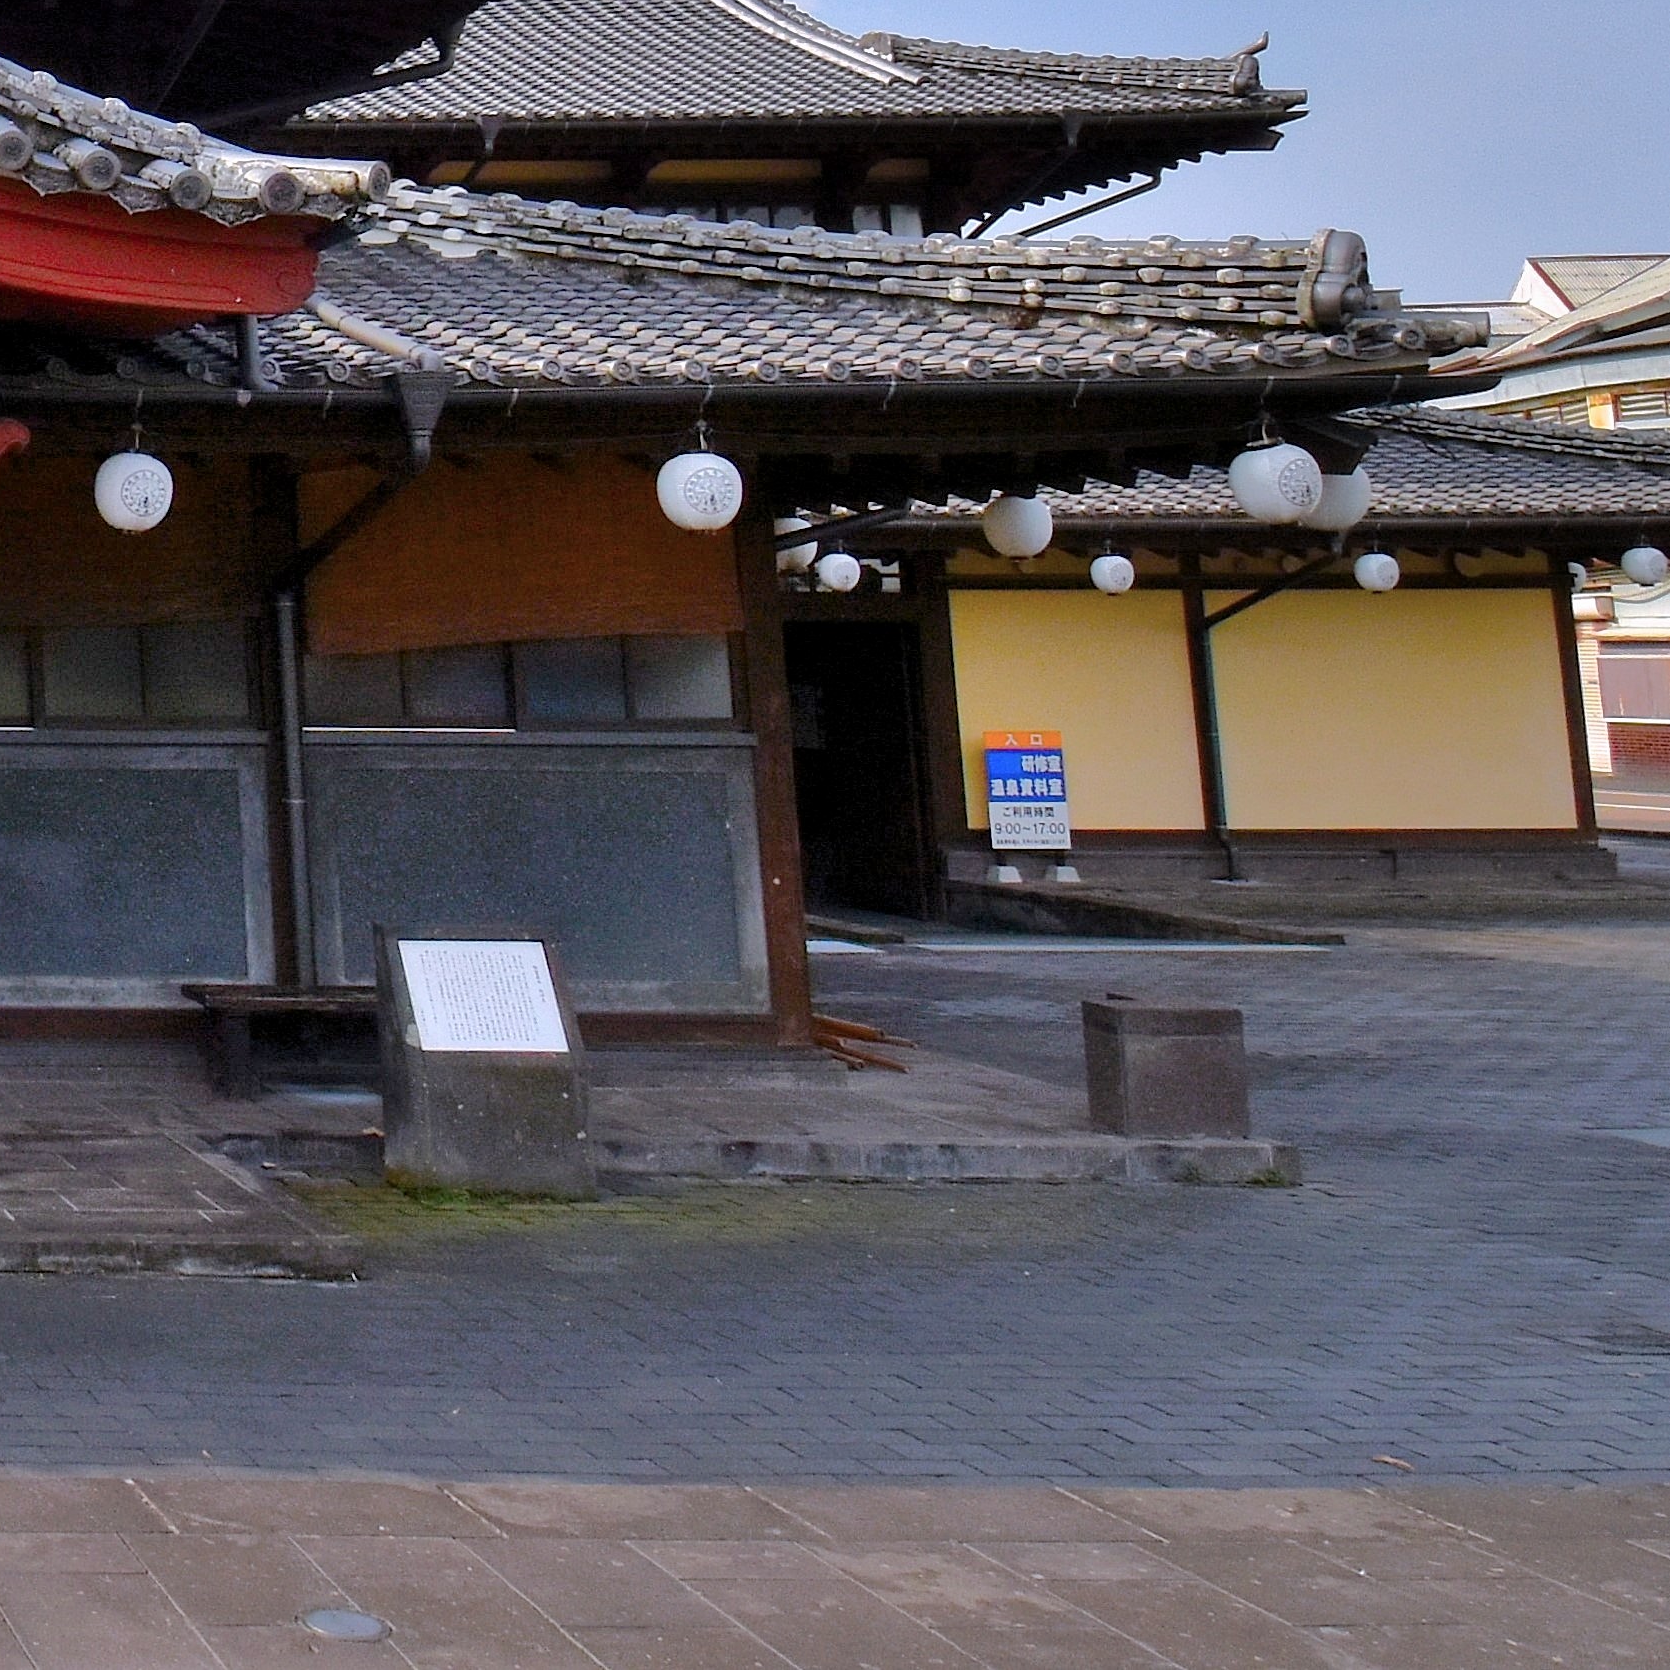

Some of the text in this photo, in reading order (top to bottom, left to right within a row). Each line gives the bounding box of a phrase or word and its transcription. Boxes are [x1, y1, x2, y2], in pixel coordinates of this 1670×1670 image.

[1005, 733, 1043, 746] 入口
[1021, 755, 1062, 773] 研修室
[990, 778, 1063, 797] 温泉資料室
[1003, 806, 1055, 818] ご利用時間
